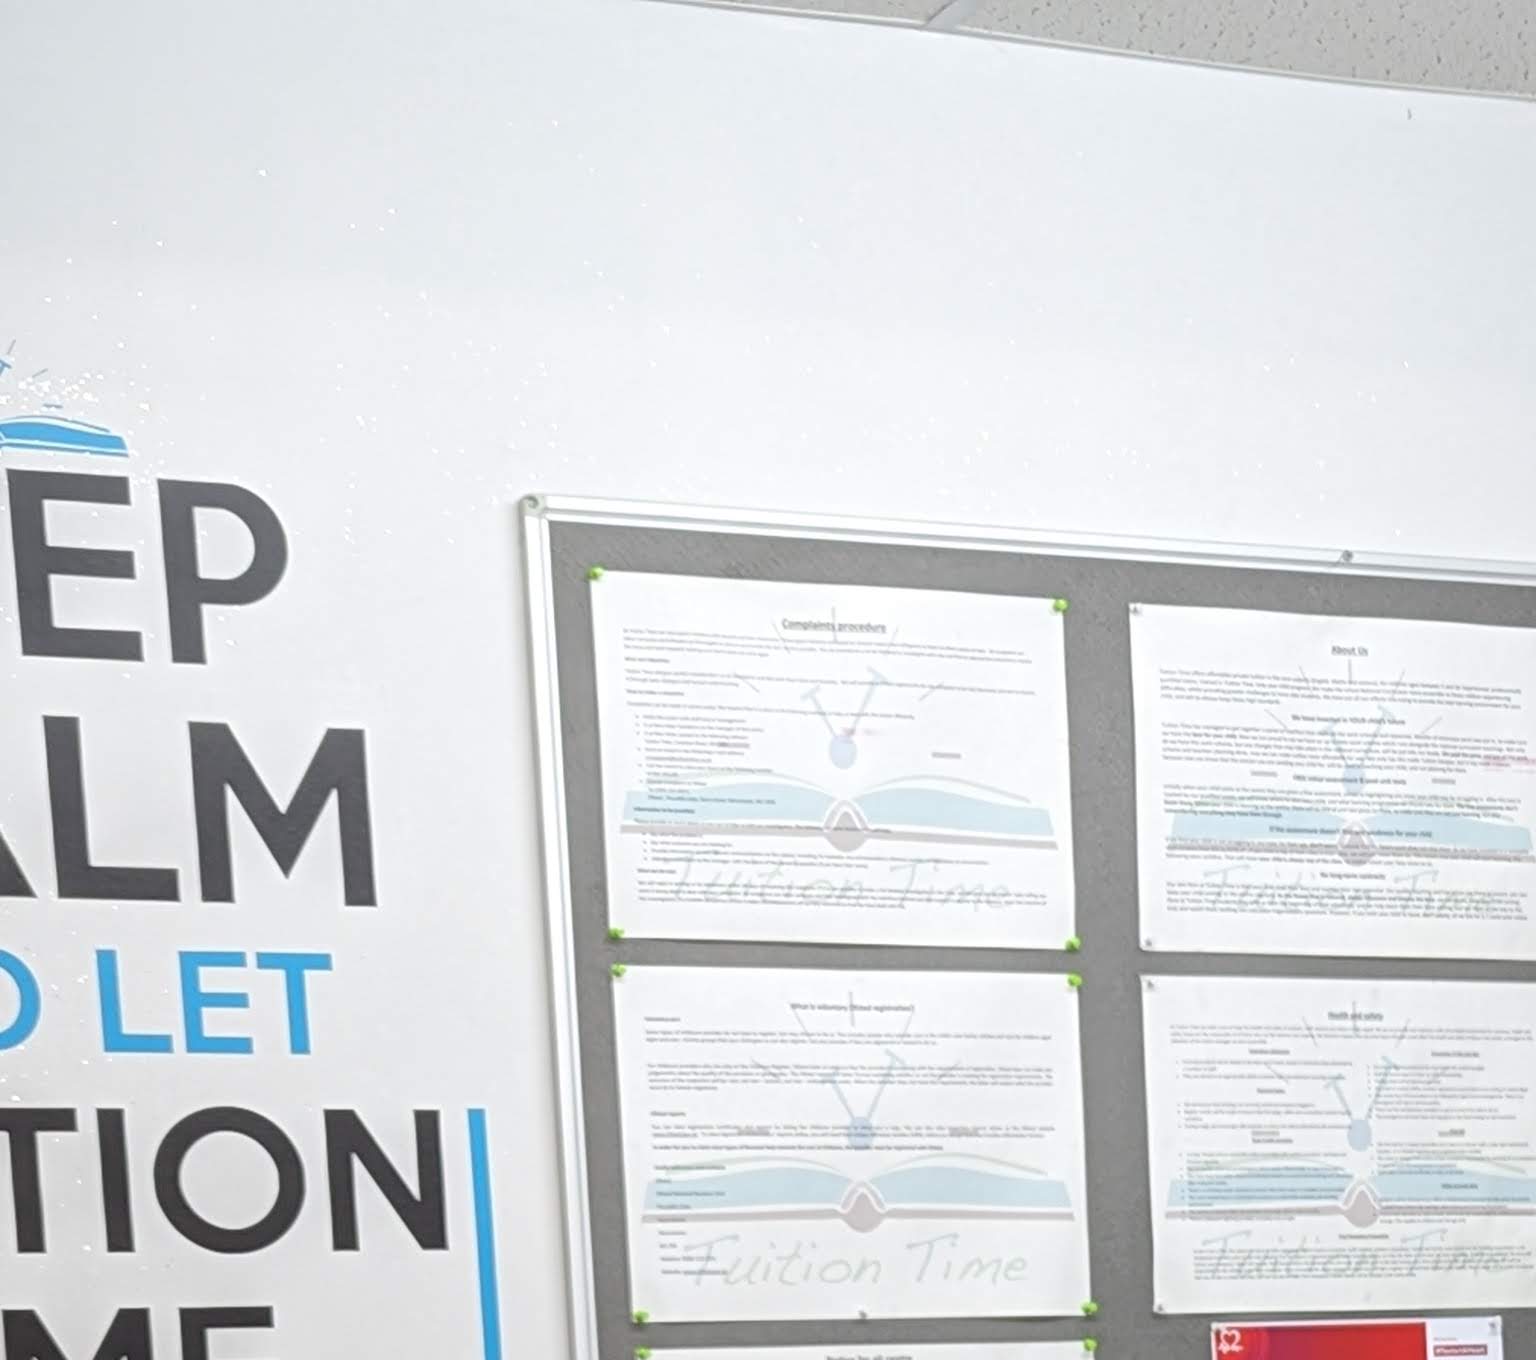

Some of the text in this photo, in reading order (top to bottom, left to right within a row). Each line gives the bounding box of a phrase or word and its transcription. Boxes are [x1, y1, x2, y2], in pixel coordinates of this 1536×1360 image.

[782, 617, 887, 634] Complaints procedure
[1331, 645, 1369, 657] About Us
[0, 714, 378, 907] LM
[96, 949, 332, 1055] LET
[682, 1232, 1031, 1286] Tuition Time
